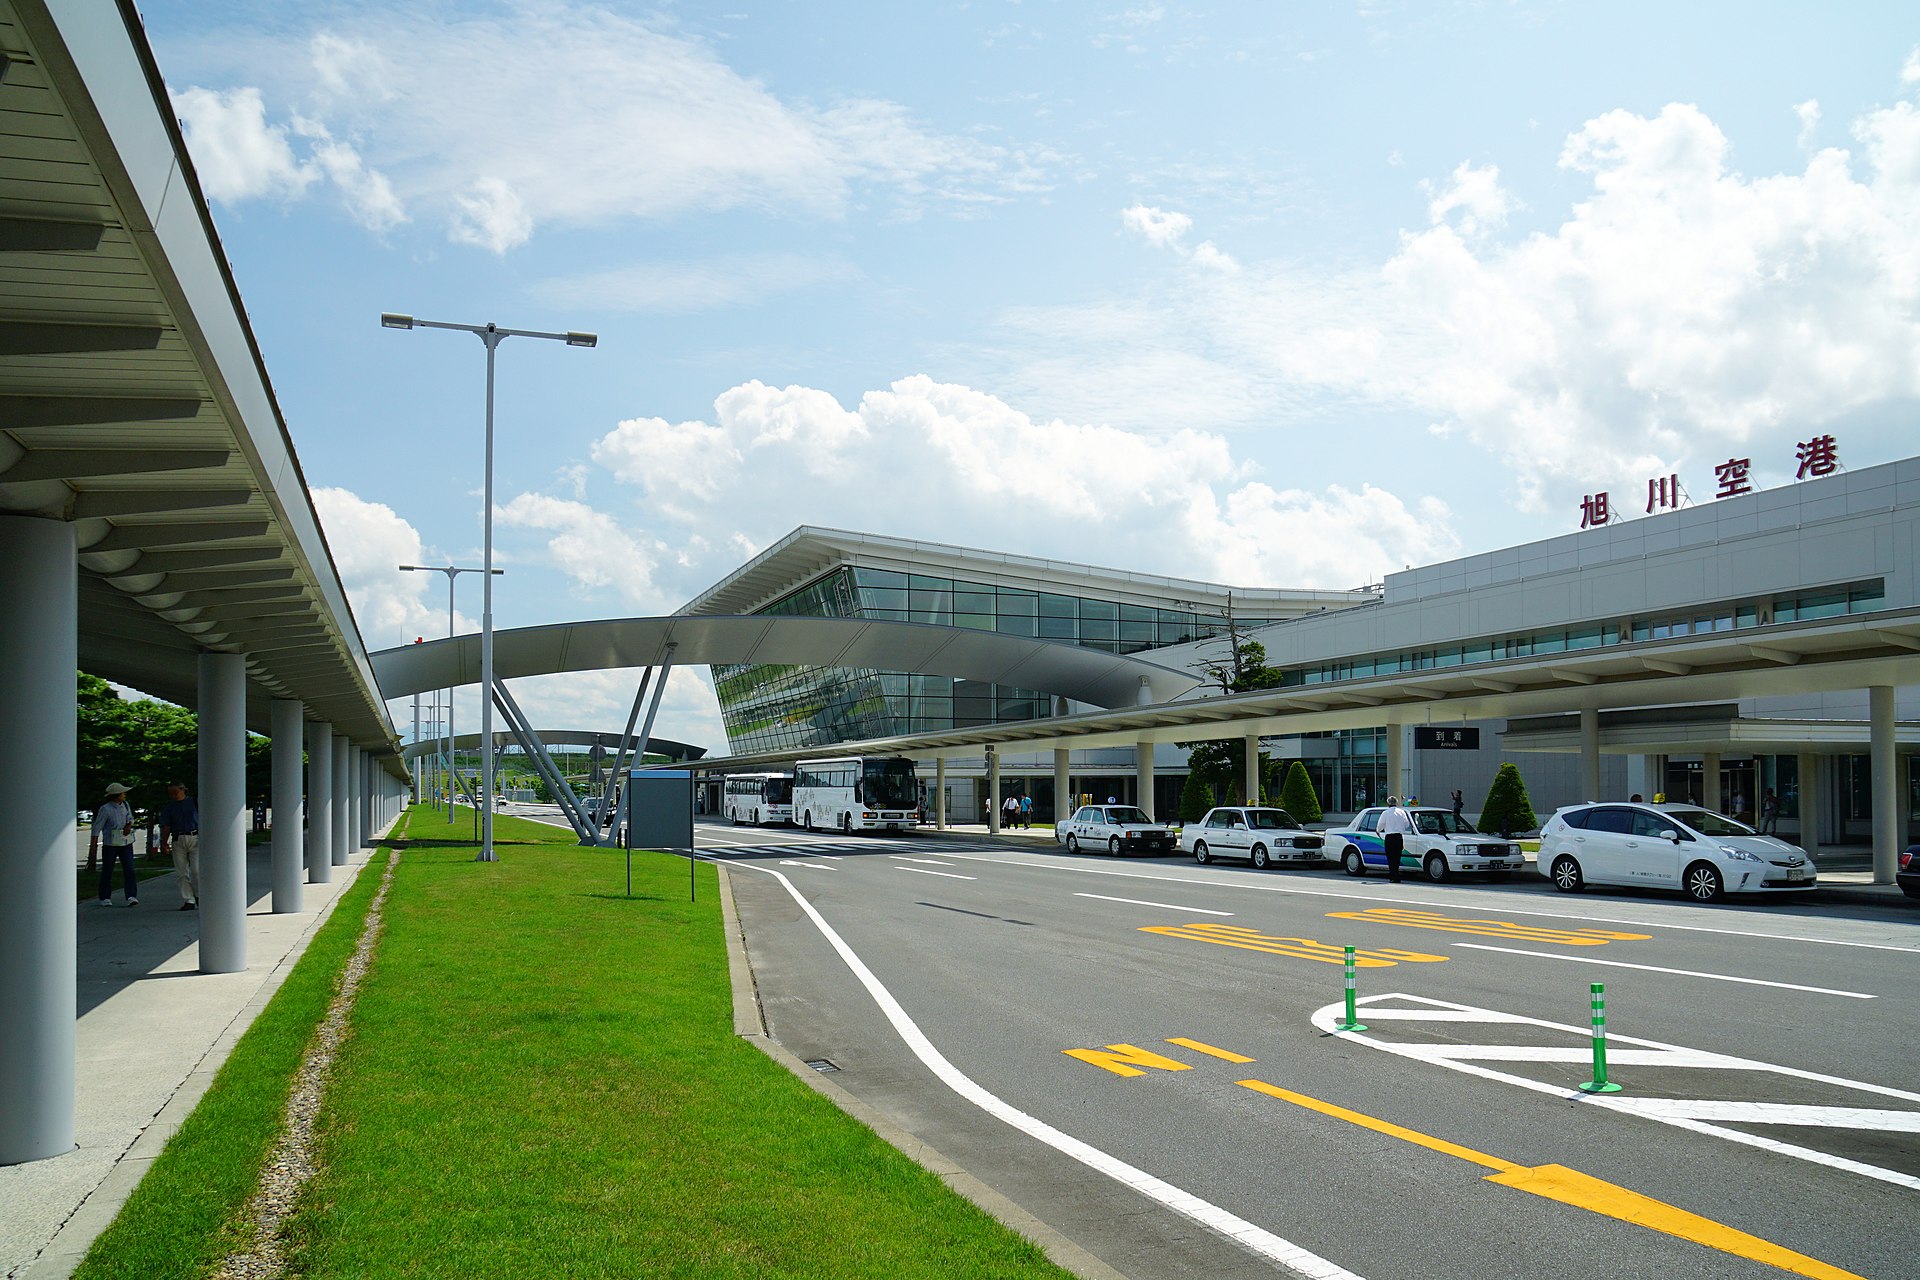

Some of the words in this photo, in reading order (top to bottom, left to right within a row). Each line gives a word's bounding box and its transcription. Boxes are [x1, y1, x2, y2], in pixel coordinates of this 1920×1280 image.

[1580, 434, 1838, 529] 旭川空港
[1435, 731, 1462, 741] 到着
